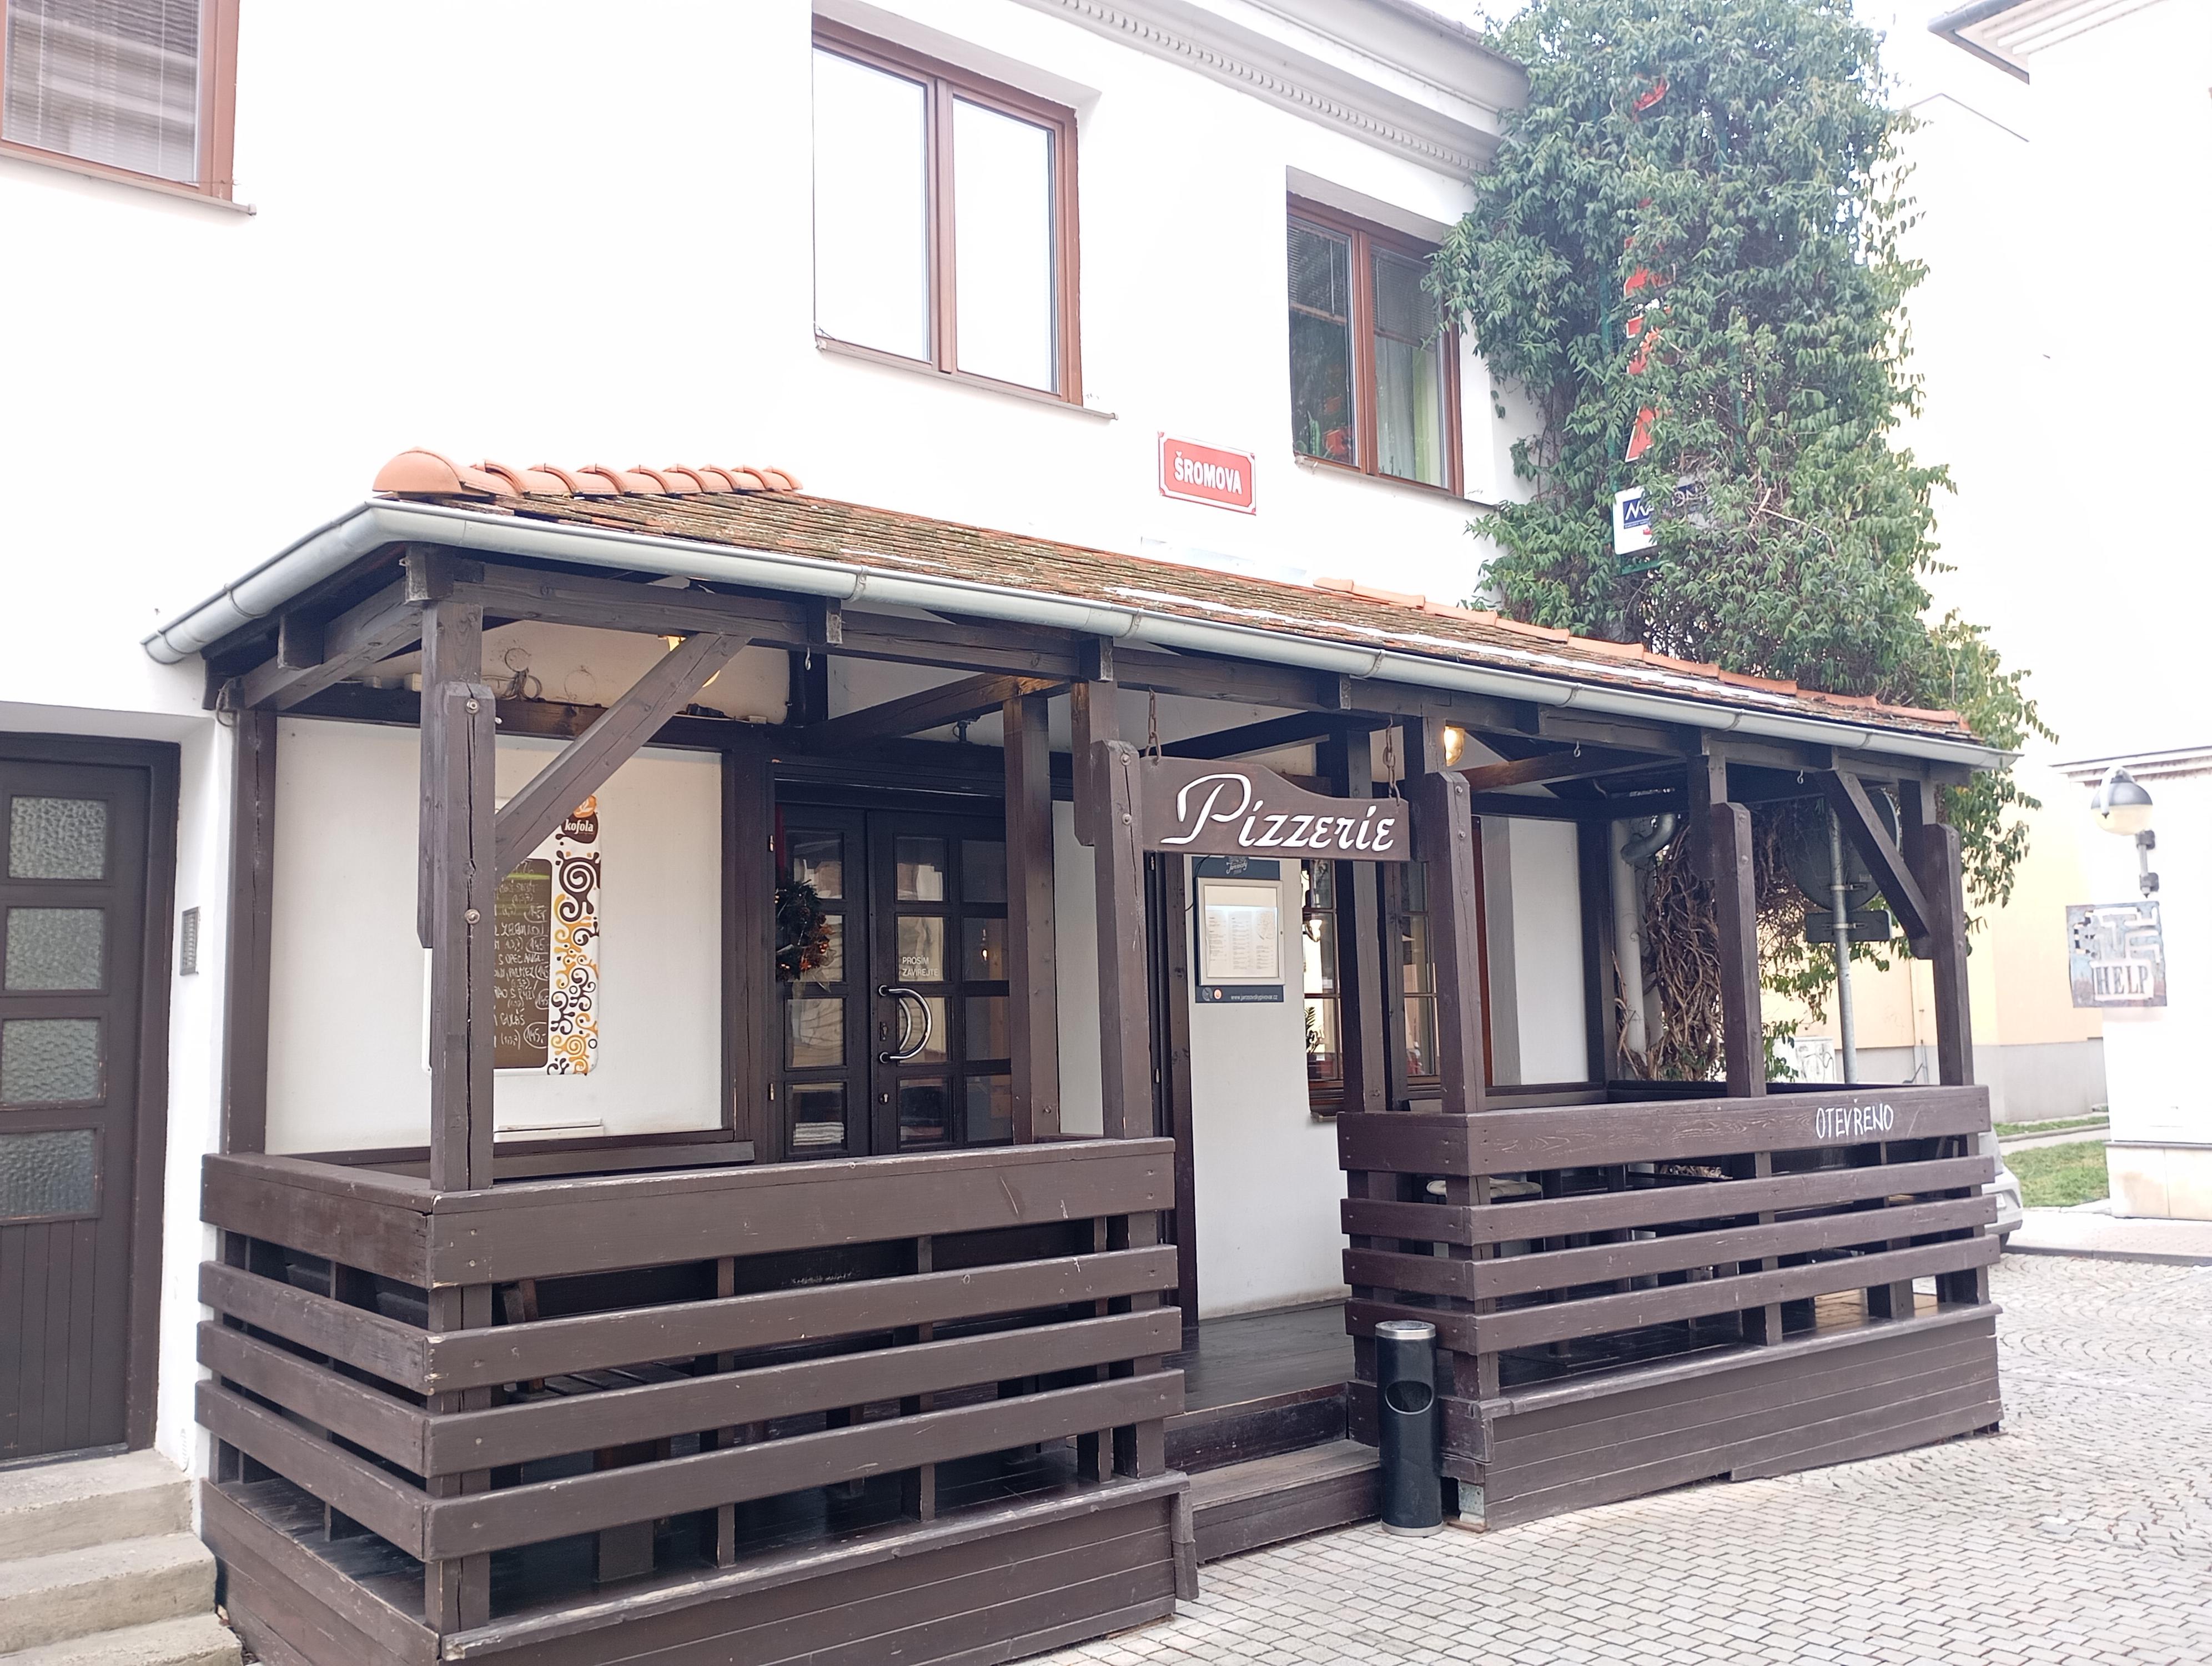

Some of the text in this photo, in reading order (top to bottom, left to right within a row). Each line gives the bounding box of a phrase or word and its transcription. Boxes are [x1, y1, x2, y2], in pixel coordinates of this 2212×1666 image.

[1173, 450, 1243, 495] ŠROMOVA
[564, 818, 594, 835] kofola
[1160, 772, 1396, 851] Pizzerie
[902, 955, 929, 965] PROSÍM
[2094, 965, 2149, 995] HELP
[1816, 1098, 1894, 1139] OTEVŘENO
